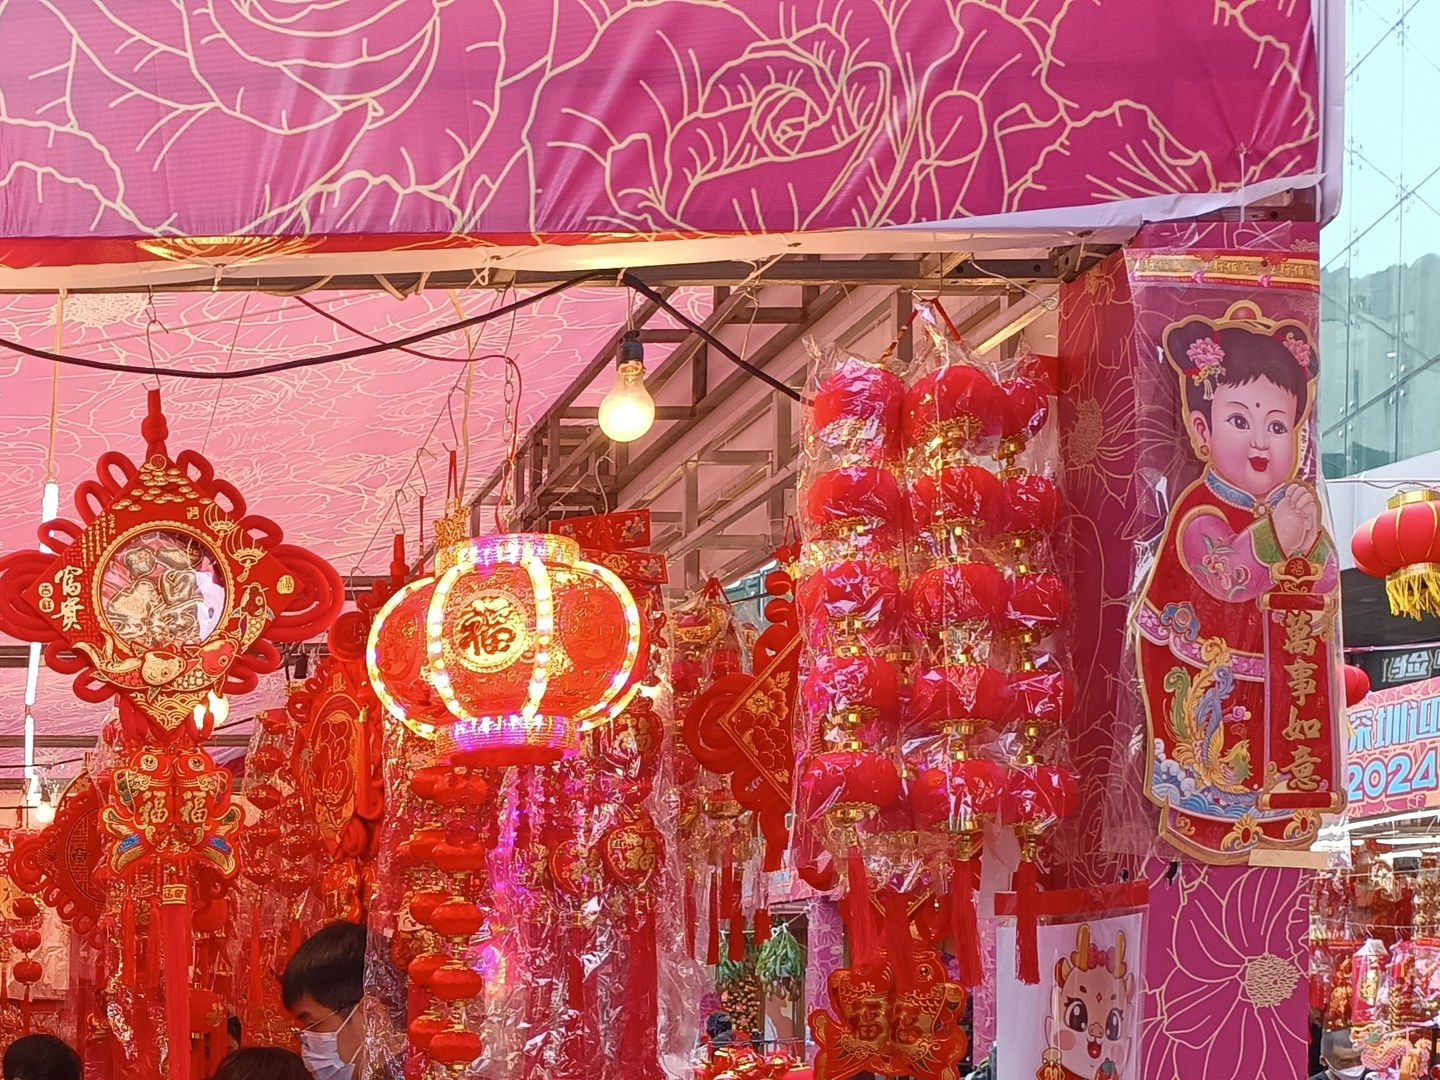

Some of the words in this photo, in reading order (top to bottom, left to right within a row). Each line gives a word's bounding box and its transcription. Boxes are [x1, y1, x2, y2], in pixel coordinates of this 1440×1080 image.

[459, 602, 517, 656] 福
[1282, 611, 1322, 791] 萬事如意
[1348, 748, 1437, 801] 2024
[140, 790, 169, 824] 福
[180, 790, 208, 824] 福
